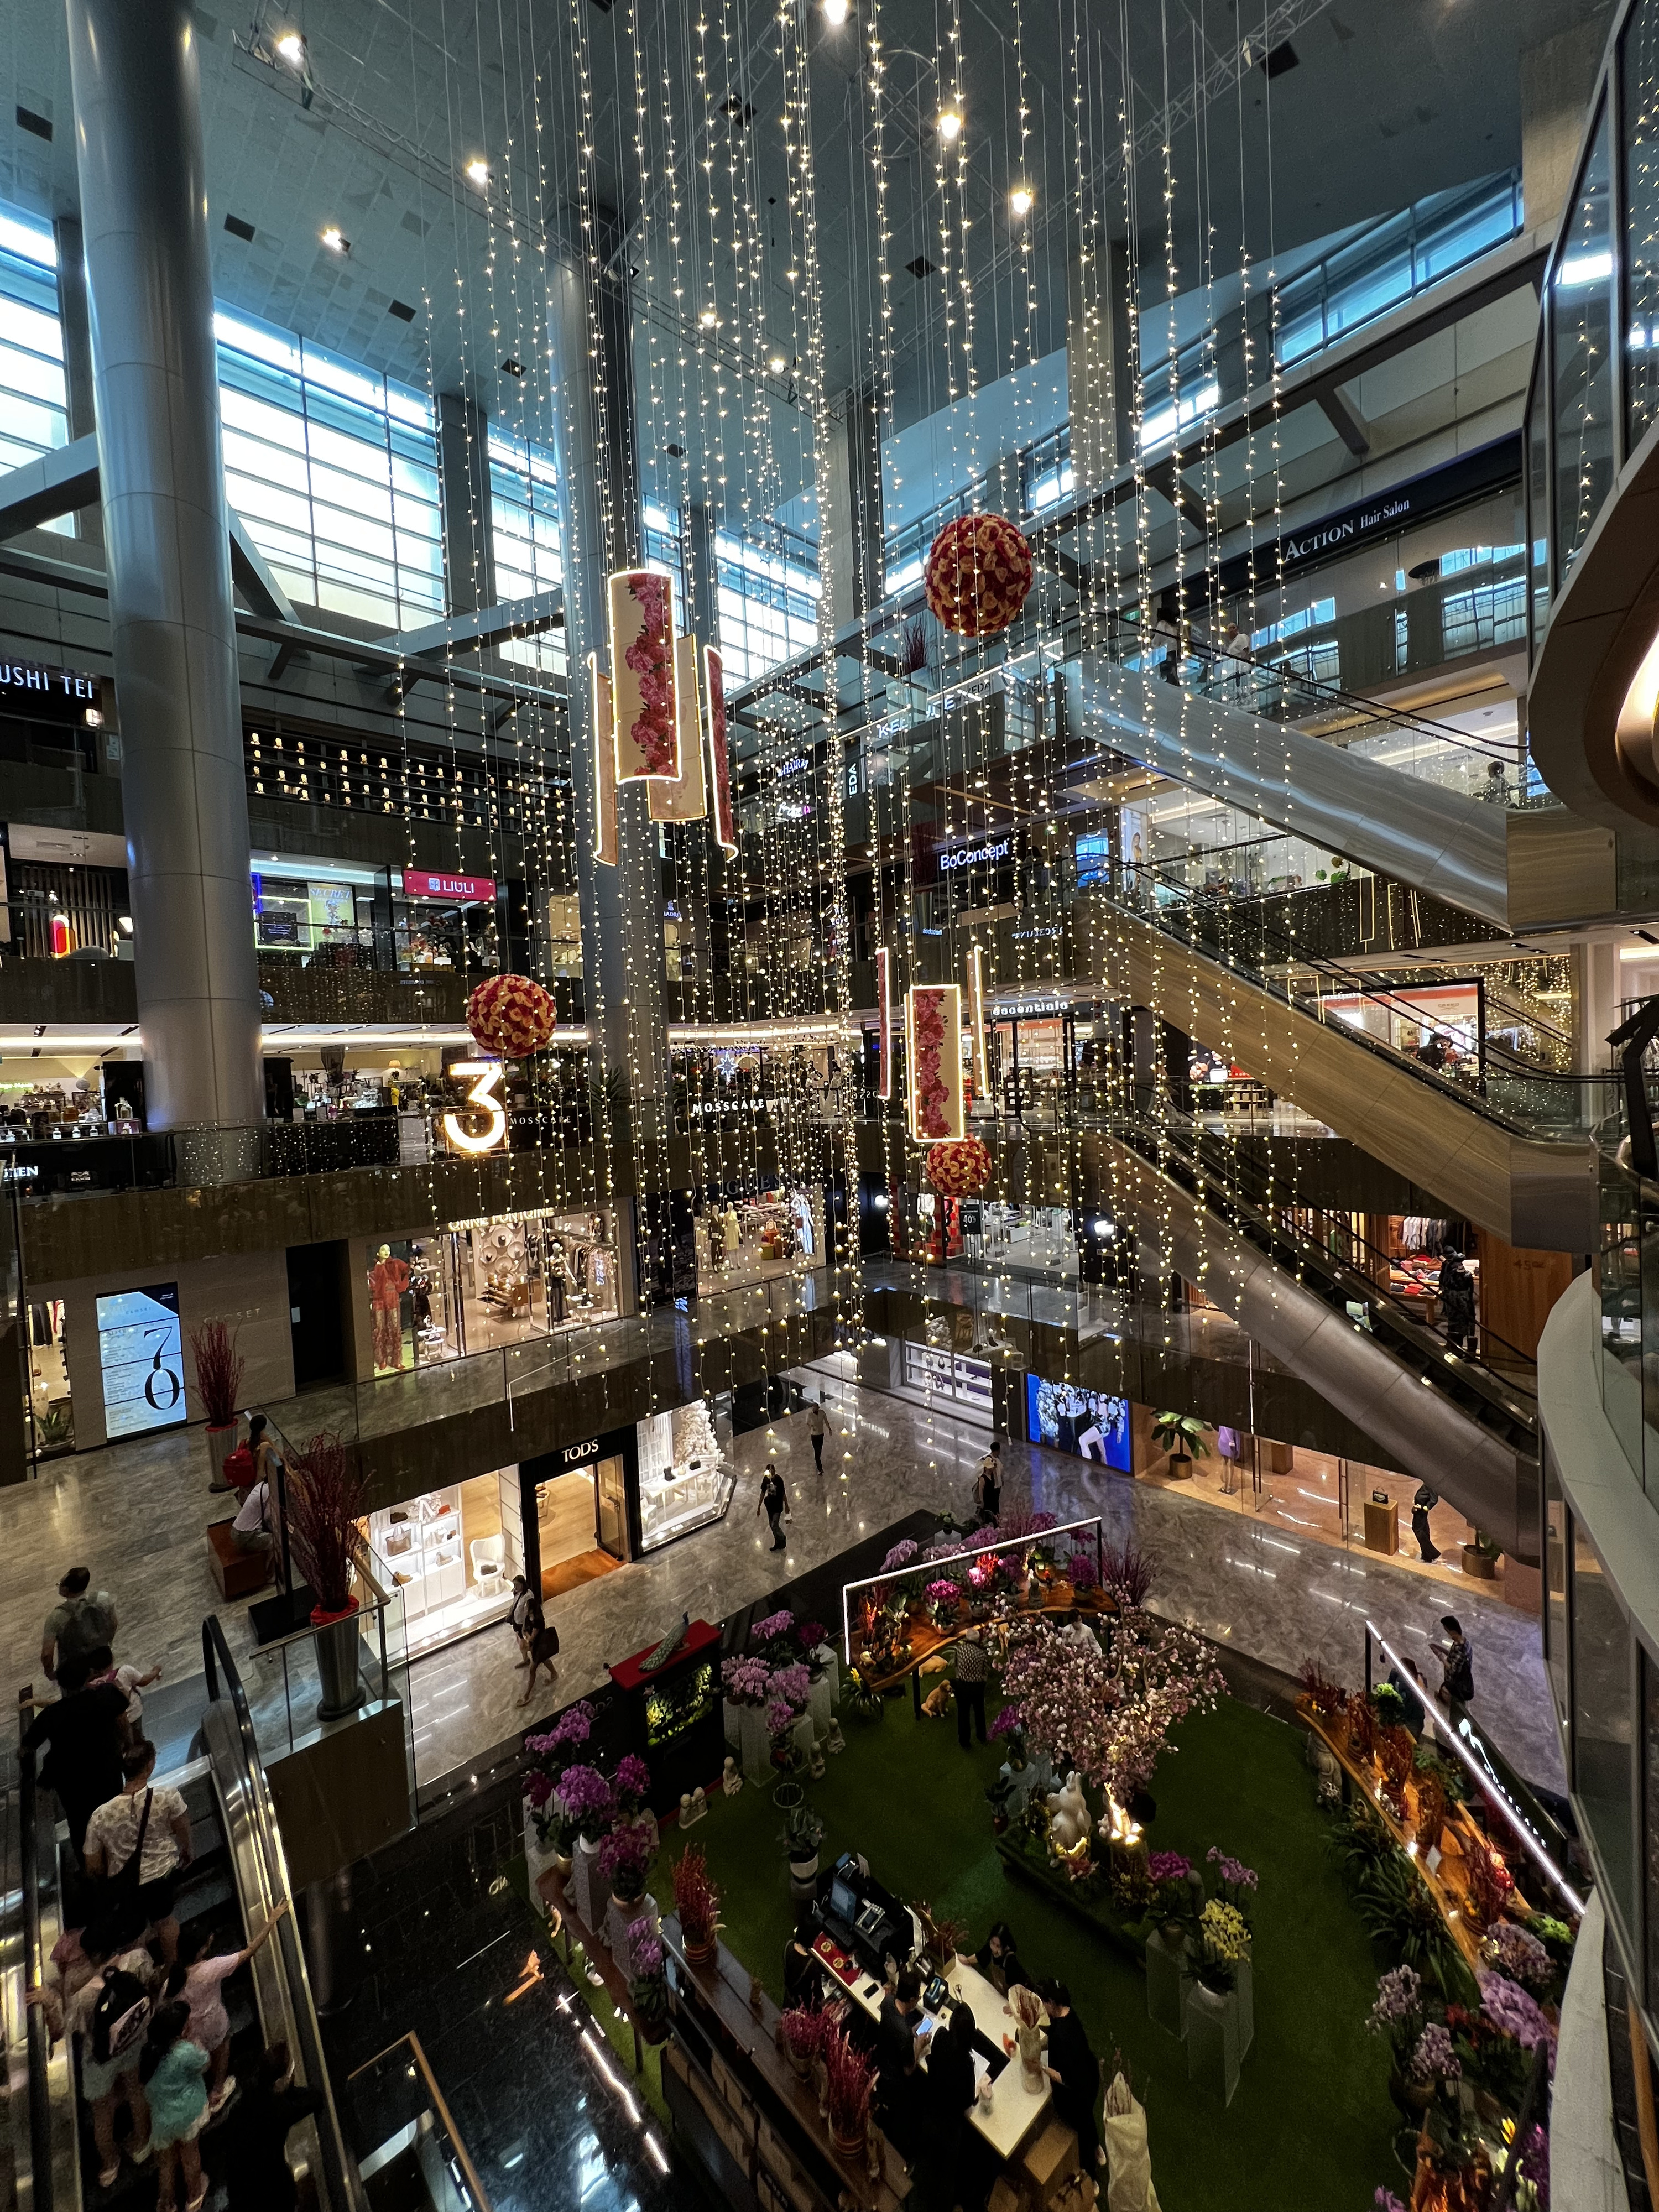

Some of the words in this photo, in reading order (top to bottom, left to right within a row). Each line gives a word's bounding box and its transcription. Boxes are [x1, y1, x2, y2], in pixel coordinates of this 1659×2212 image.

[1284, 520, 1354, 563] ACTION
[1360, 510, 1381, 529] Hair
[1383, 500, 1410, 519] Salon
[60, 675, 93, 699] TEI
[940, 839, 1009, 870] BoConcept
[310, 888, 351, 899] SECRET
[993, 1000, 1068, 1016] escentials
[444, 1062, 505, 1151] 3
[692, 1099, 764, 1114] MOSSCAPE
[510, 1115, 572, 1125] MOSSCAPE
[561, 1439, 599, 1463] TOD'S
